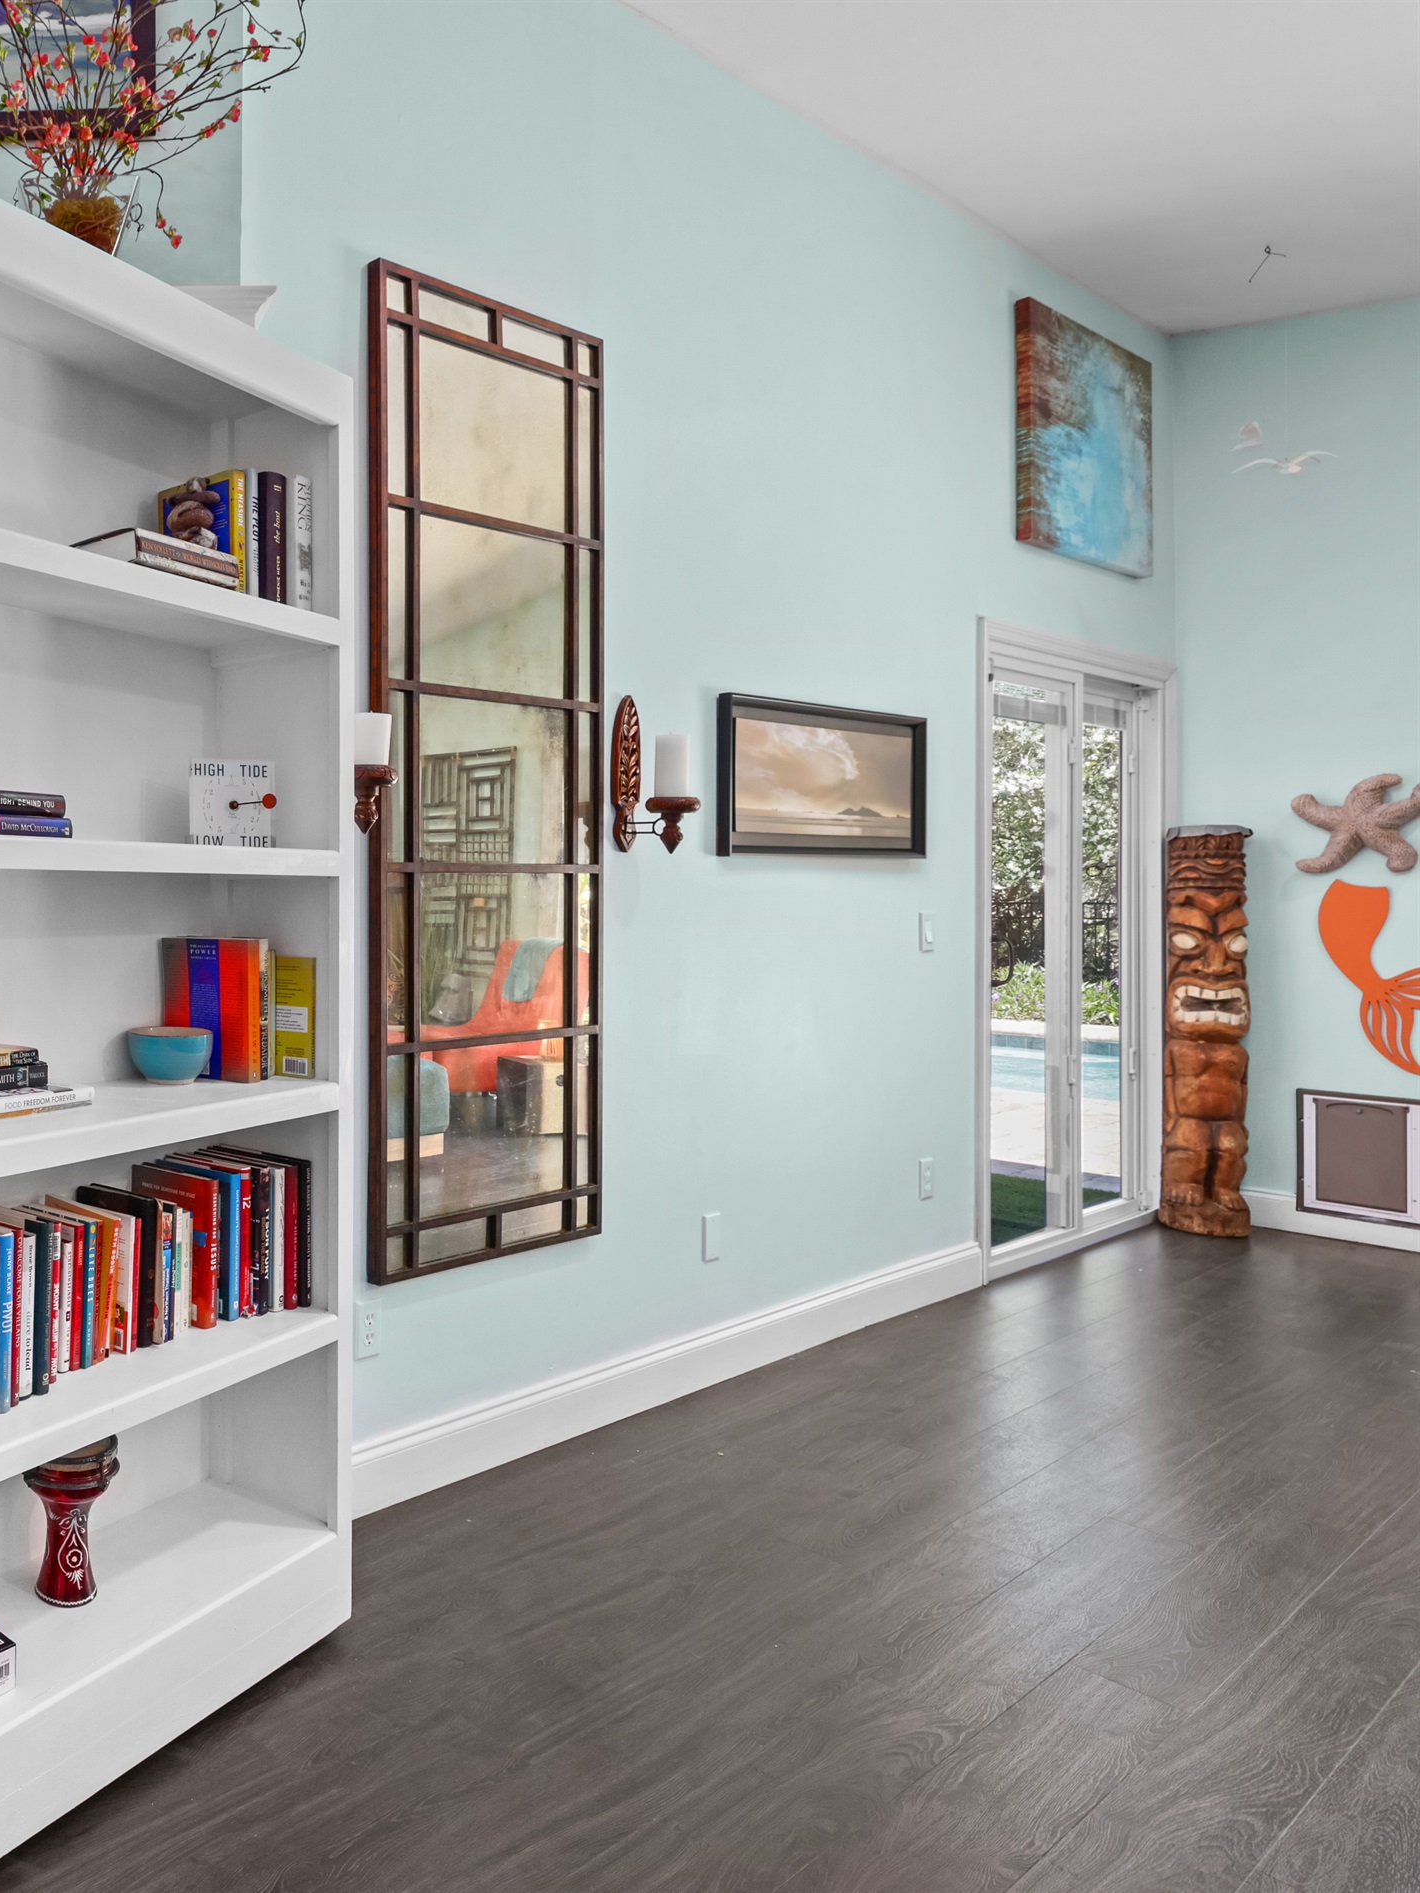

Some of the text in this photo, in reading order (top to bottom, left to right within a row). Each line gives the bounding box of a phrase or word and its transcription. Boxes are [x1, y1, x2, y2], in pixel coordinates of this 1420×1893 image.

[297, 482, 307, 531] KING
[273, 510, 281, 544] the host
[141, 541, 154, 550] KEN
[153, 544, 176, 557] FOLLETT
[182, 552, 200, 563] WORLD
[202, 557, 225, 570] WITHOUT
[194, 763, 268, 778] HIGH TIDE
[42, 800, 55, 809] YOU
[240, 836, 269, 848] TIDE
[4, 1093, 77, 1110] FOOD FREEDOM FOREVER
[242, 1195, 251, 1209] 12
[16, 1236, 24, 1284] OVERCOME
[88, 1247, 97, 1272] LOVE
[109, 1250, 118, 1274] GODIN
[15, 1285, 23, 1309] YOUR
[87, 1277, 96, 1302] DOES
[104, 1283, 112, 1320] LINCHPIN
[1, 1301, 13, 1334] PIVOT
[26, 1338, 32, 1347] to
[50, 1357, 58, 1376] HOW
